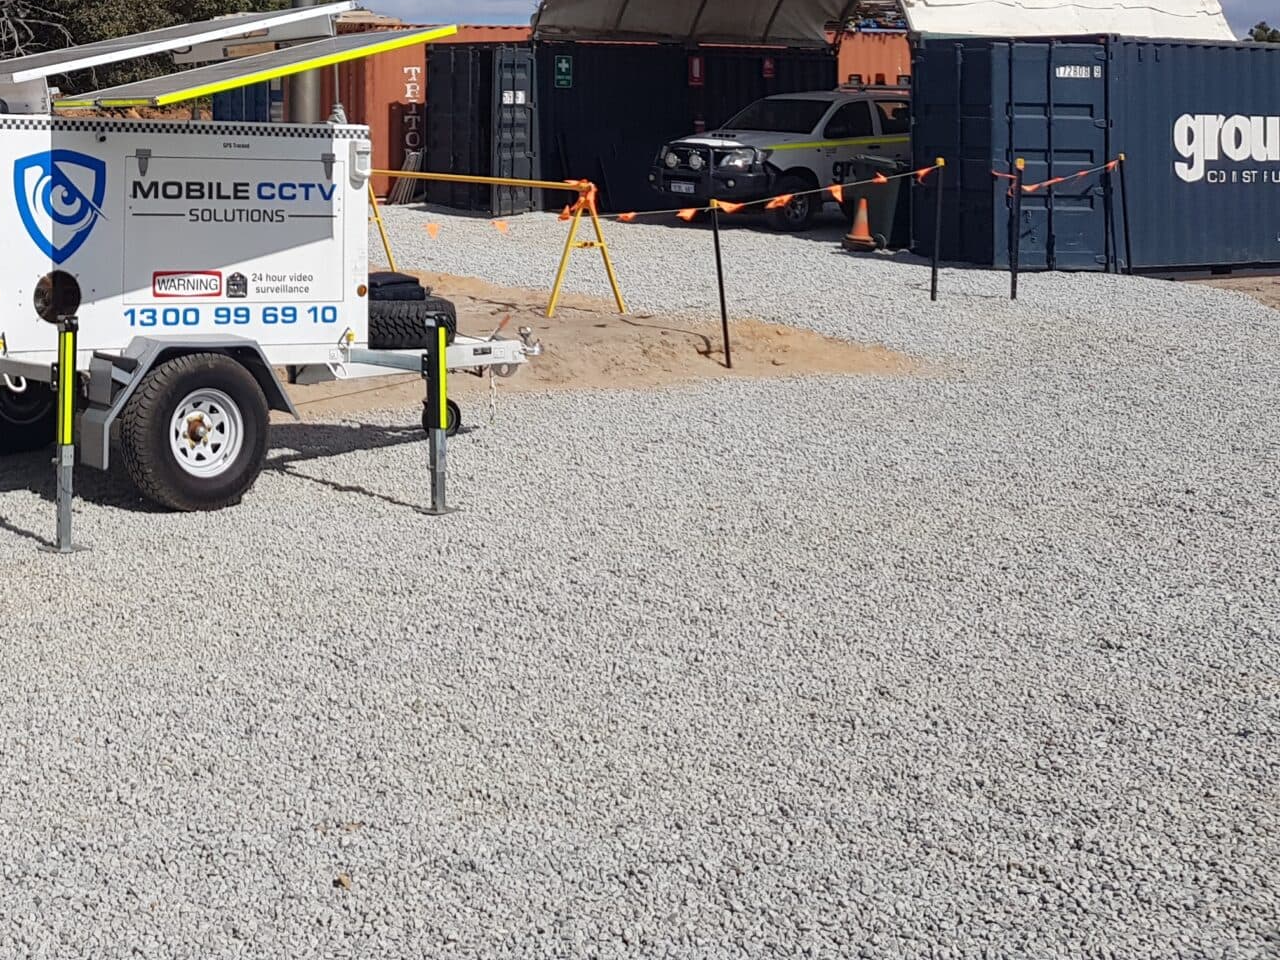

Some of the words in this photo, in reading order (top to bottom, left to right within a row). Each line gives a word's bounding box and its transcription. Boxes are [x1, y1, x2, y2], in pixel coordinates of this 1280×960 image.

[132, 180, 250, 200] MOBILE
[256, 182, 337, 201] CCTV
[189, 208, 285, 223] SOLUTIONS
[251, 272, 263, 282] 24
[265, 272, 287, 282] hour
[289, 272, 314, 282] video
[157, 278, 219, 291] WARNING
[255, 284, 310, 294] surveillance
[124, 308, 200, 327] 1300
[214, 306, 251, 325] 99
[262, 306, 298, 324] 69
[307, 305, 338, 323] 10
